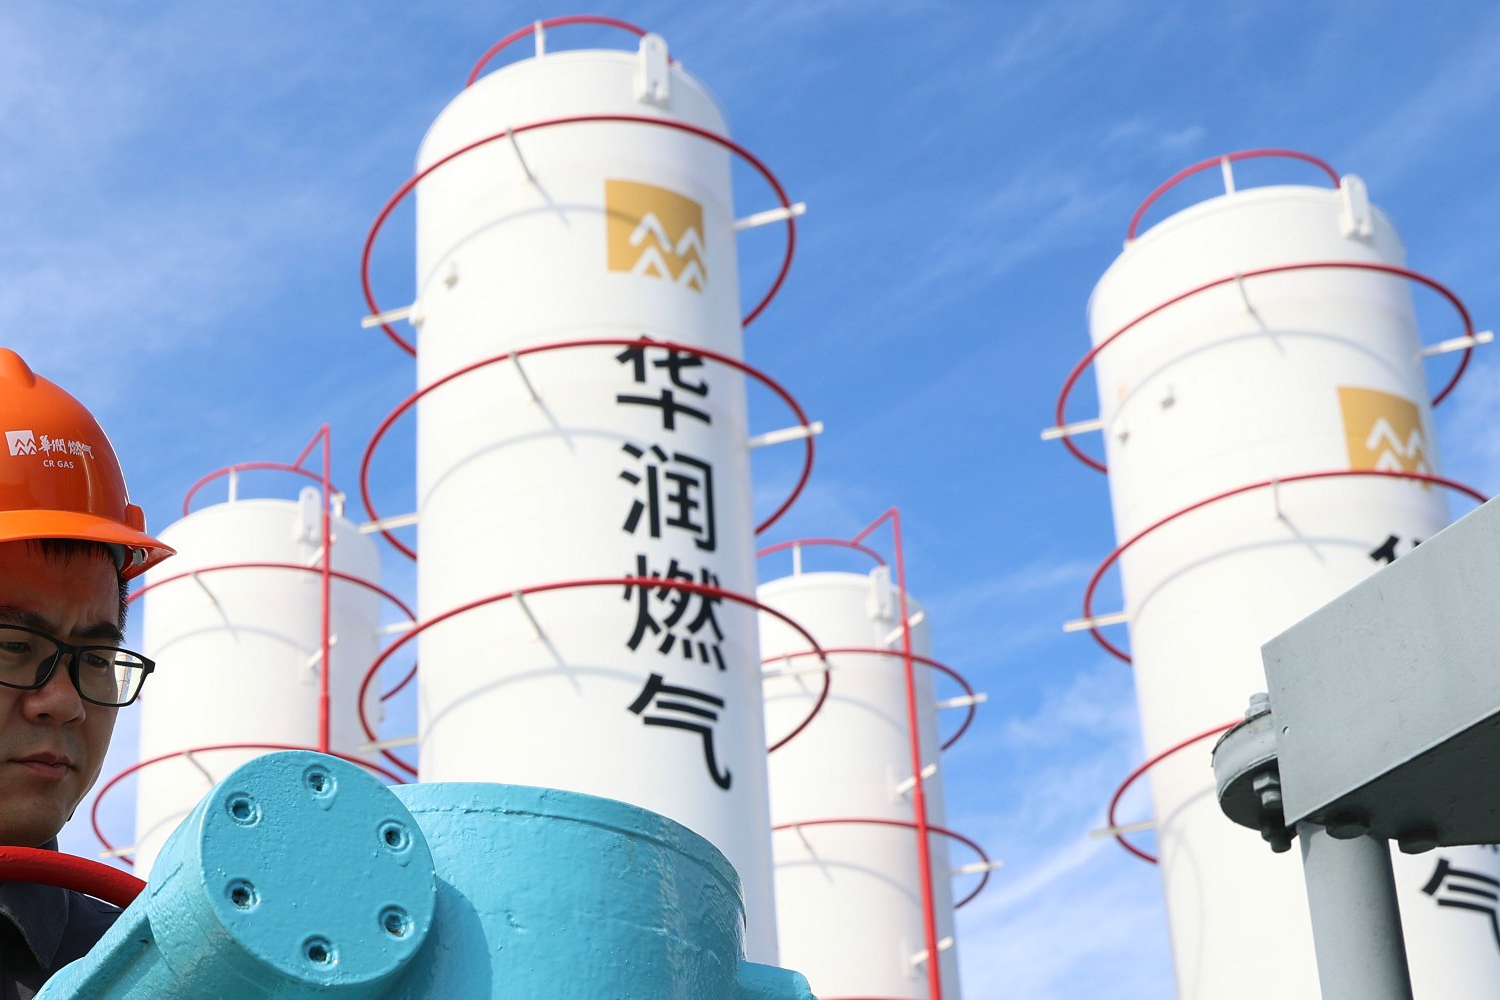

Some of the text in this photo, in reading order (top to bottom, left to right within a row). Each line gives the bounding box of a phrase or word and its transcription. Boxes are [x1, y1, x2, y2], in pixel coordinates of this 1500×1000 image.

[43, 459, 74, 469] CR GAS
[614, 335, 732, 791] 华润燃气
